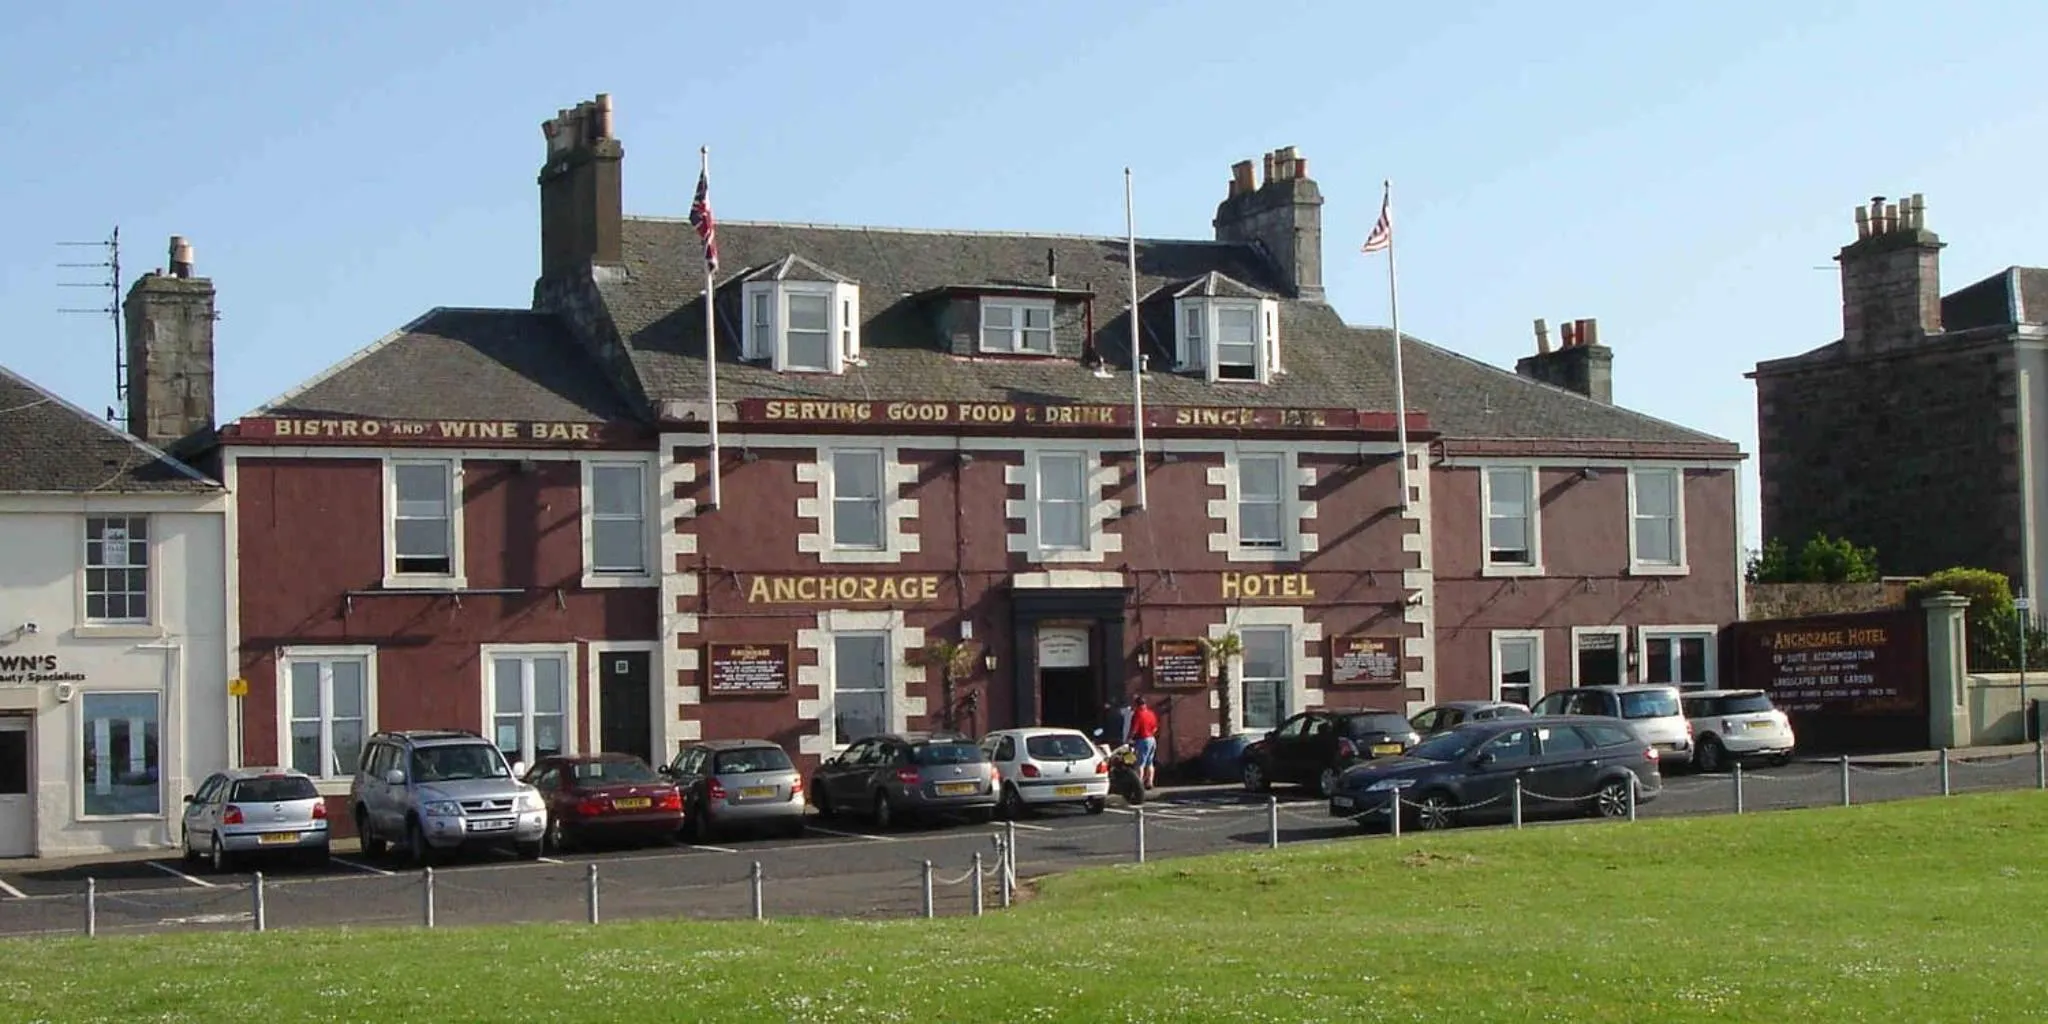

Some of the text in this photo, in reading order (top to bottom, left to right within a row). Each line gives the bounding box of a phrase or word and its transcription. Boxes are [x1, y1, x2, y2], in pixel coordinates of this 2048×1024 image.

[765, 402, 872, 421] SERVING
[887, 403, 949, 421] GOOD
[959, 404, 1016, 422] FOOD
[1045, 407, 1114, 423] DRINK
[274, 420, 590, 439] BISTRO AND WINE BAR
[748, 572, 1316, 603] ANCHORAGE HOTEL
[1849, 628, 1888, 645] HOTEL
[28, 672, 86, 683] Specialists
